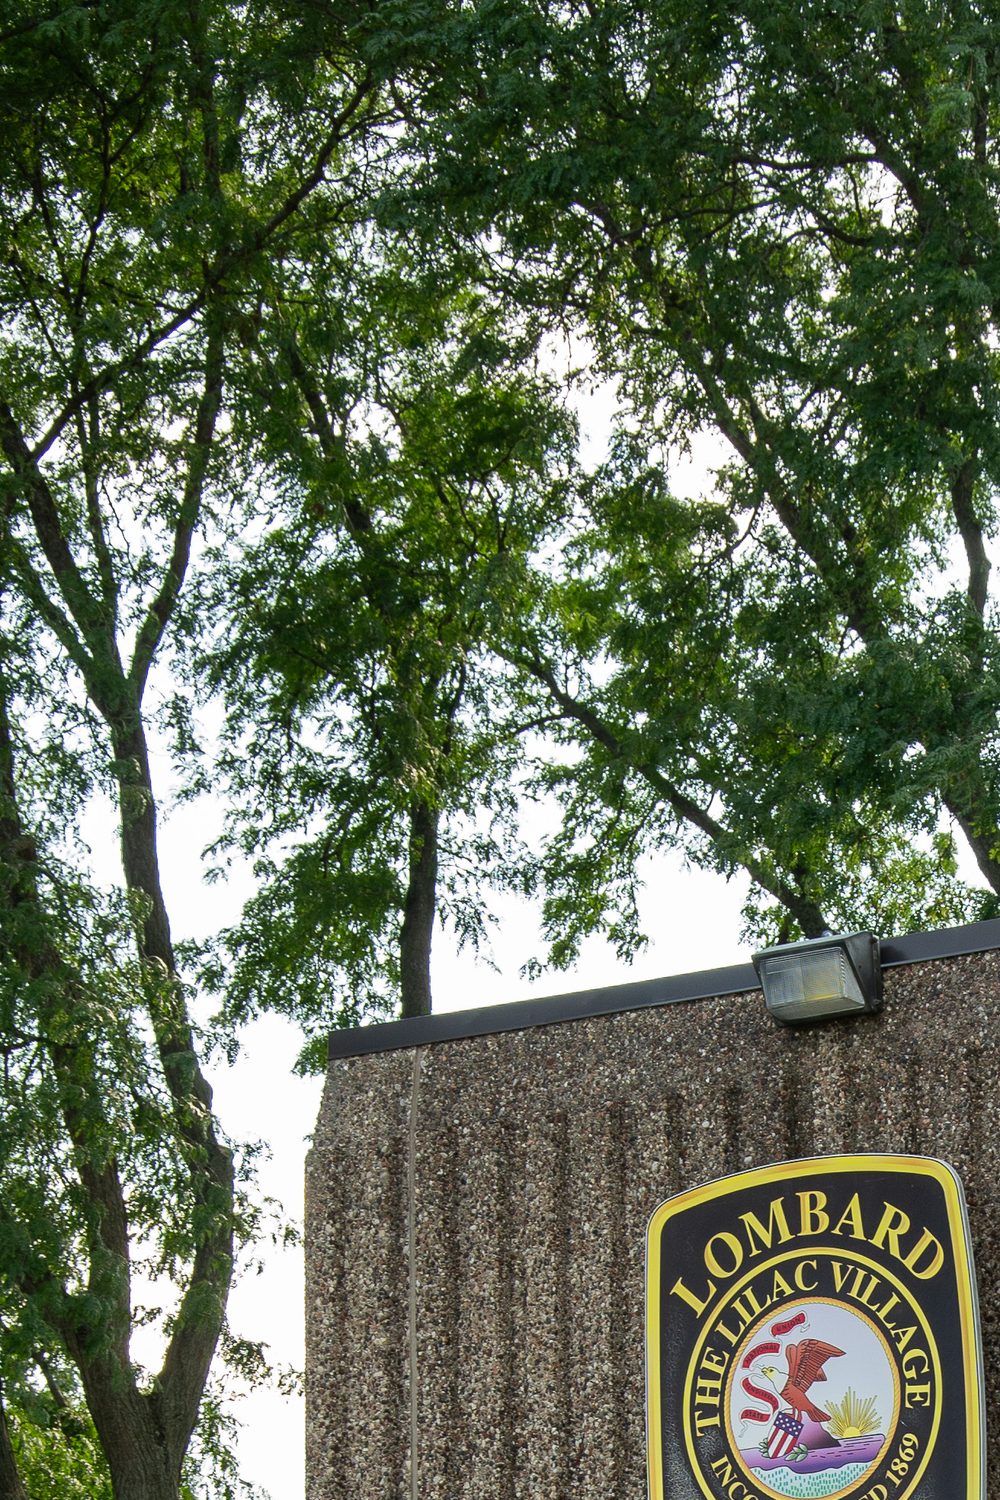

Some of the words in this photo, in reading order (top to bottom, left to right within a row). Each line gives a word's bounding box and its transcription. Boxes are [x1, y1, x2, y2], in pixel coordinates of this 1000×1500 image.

[670, 1190, 945, 1319] LOMBARD
[694, 1347, 729, 1437] THE
[715, 1259, 819, 1348] LILAC
[830, 1262, 931, 1409] VILLAGE
[885, 1432, 919, 1489] 1869
